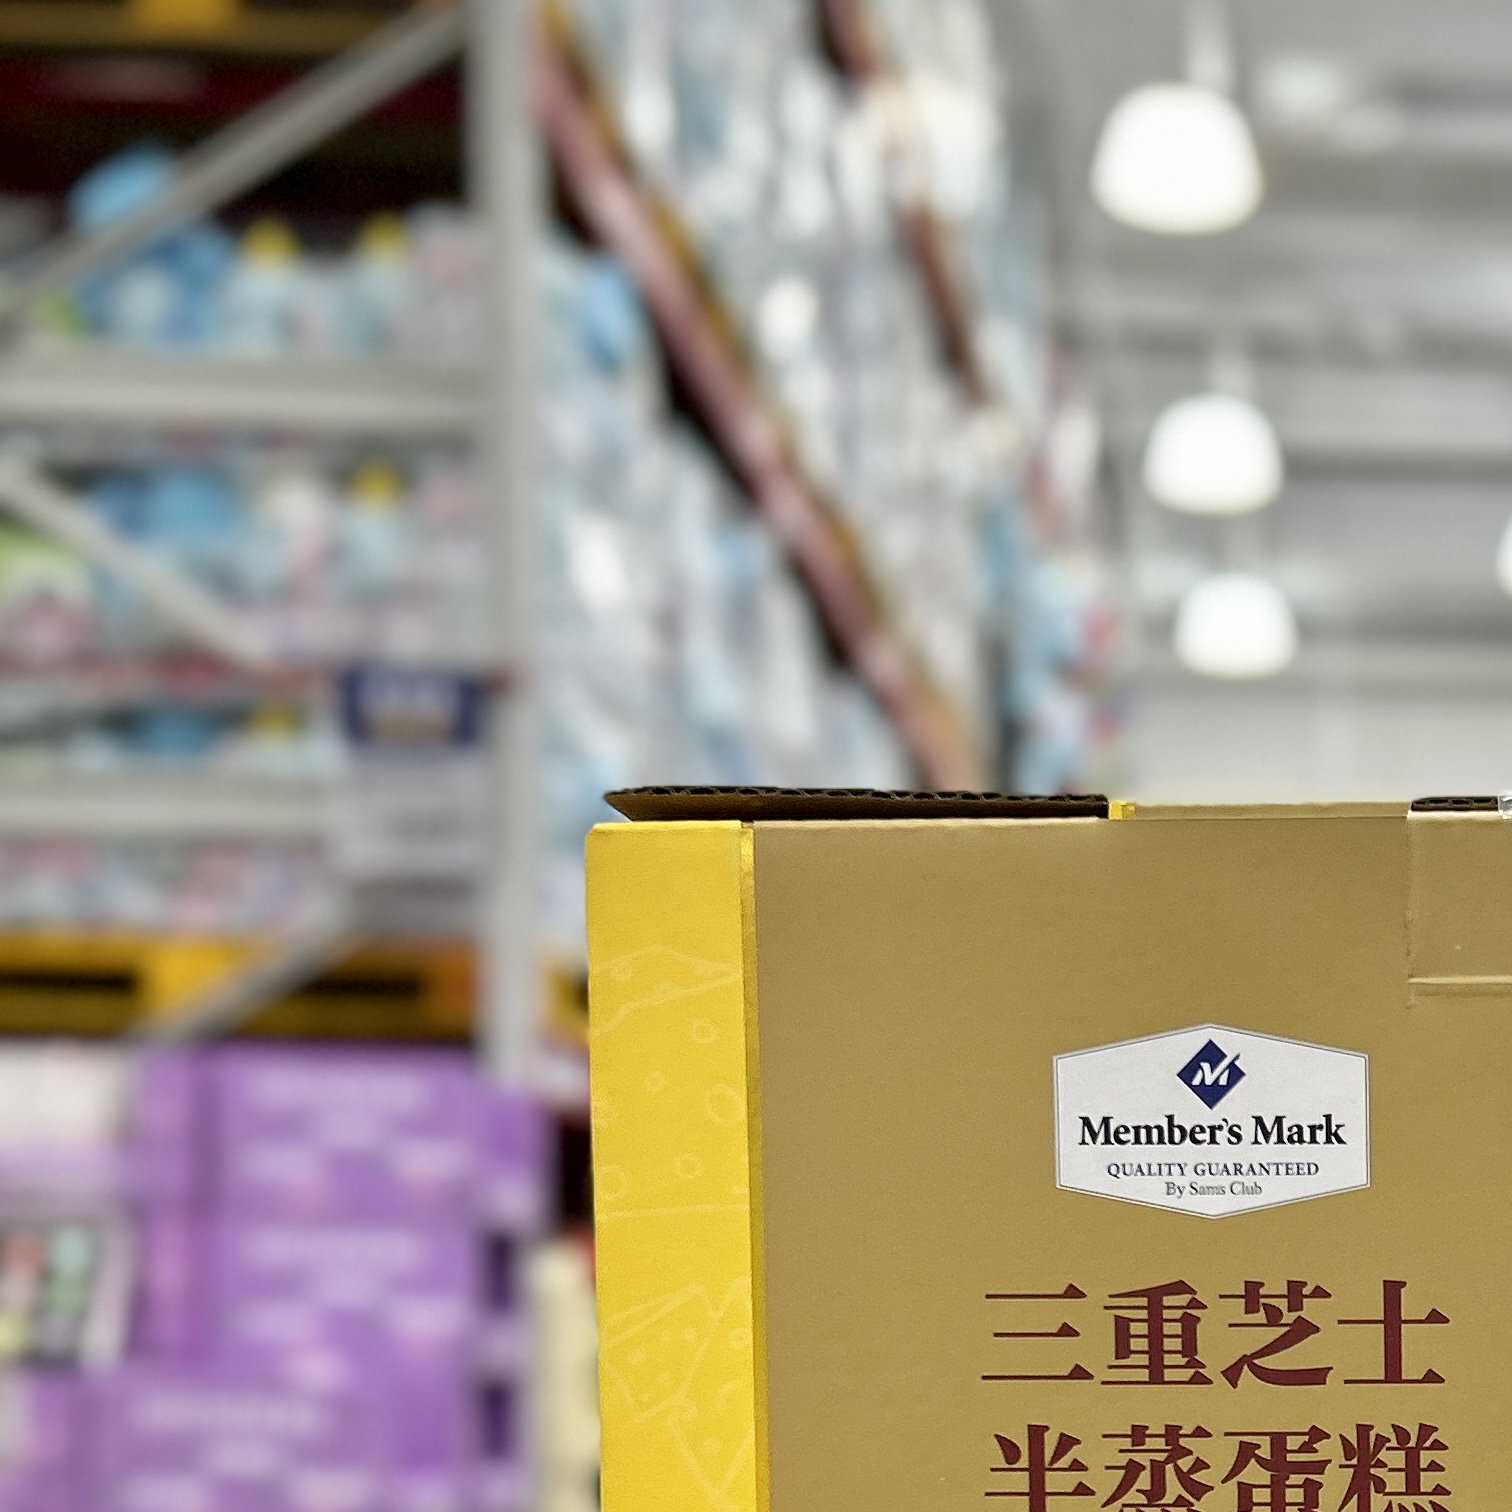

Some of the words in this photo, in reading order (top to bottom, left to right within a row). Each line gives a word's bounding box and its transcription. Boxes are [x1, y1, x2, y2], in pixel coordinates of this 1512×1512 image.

[1078, 1115, 1243, 1146] Member's
[1251, 1114, 1348, 1146] Mark
[1106, 1162, 1187, 1178] QUALITY
[1193, 1162, 1319, 1177] GUARANTEED
[1164, 1181, 1186, 1200] By
[1229, 1181, 1263, 1196] Club
[981, 1279, 1452, 1389] 三重芝士
